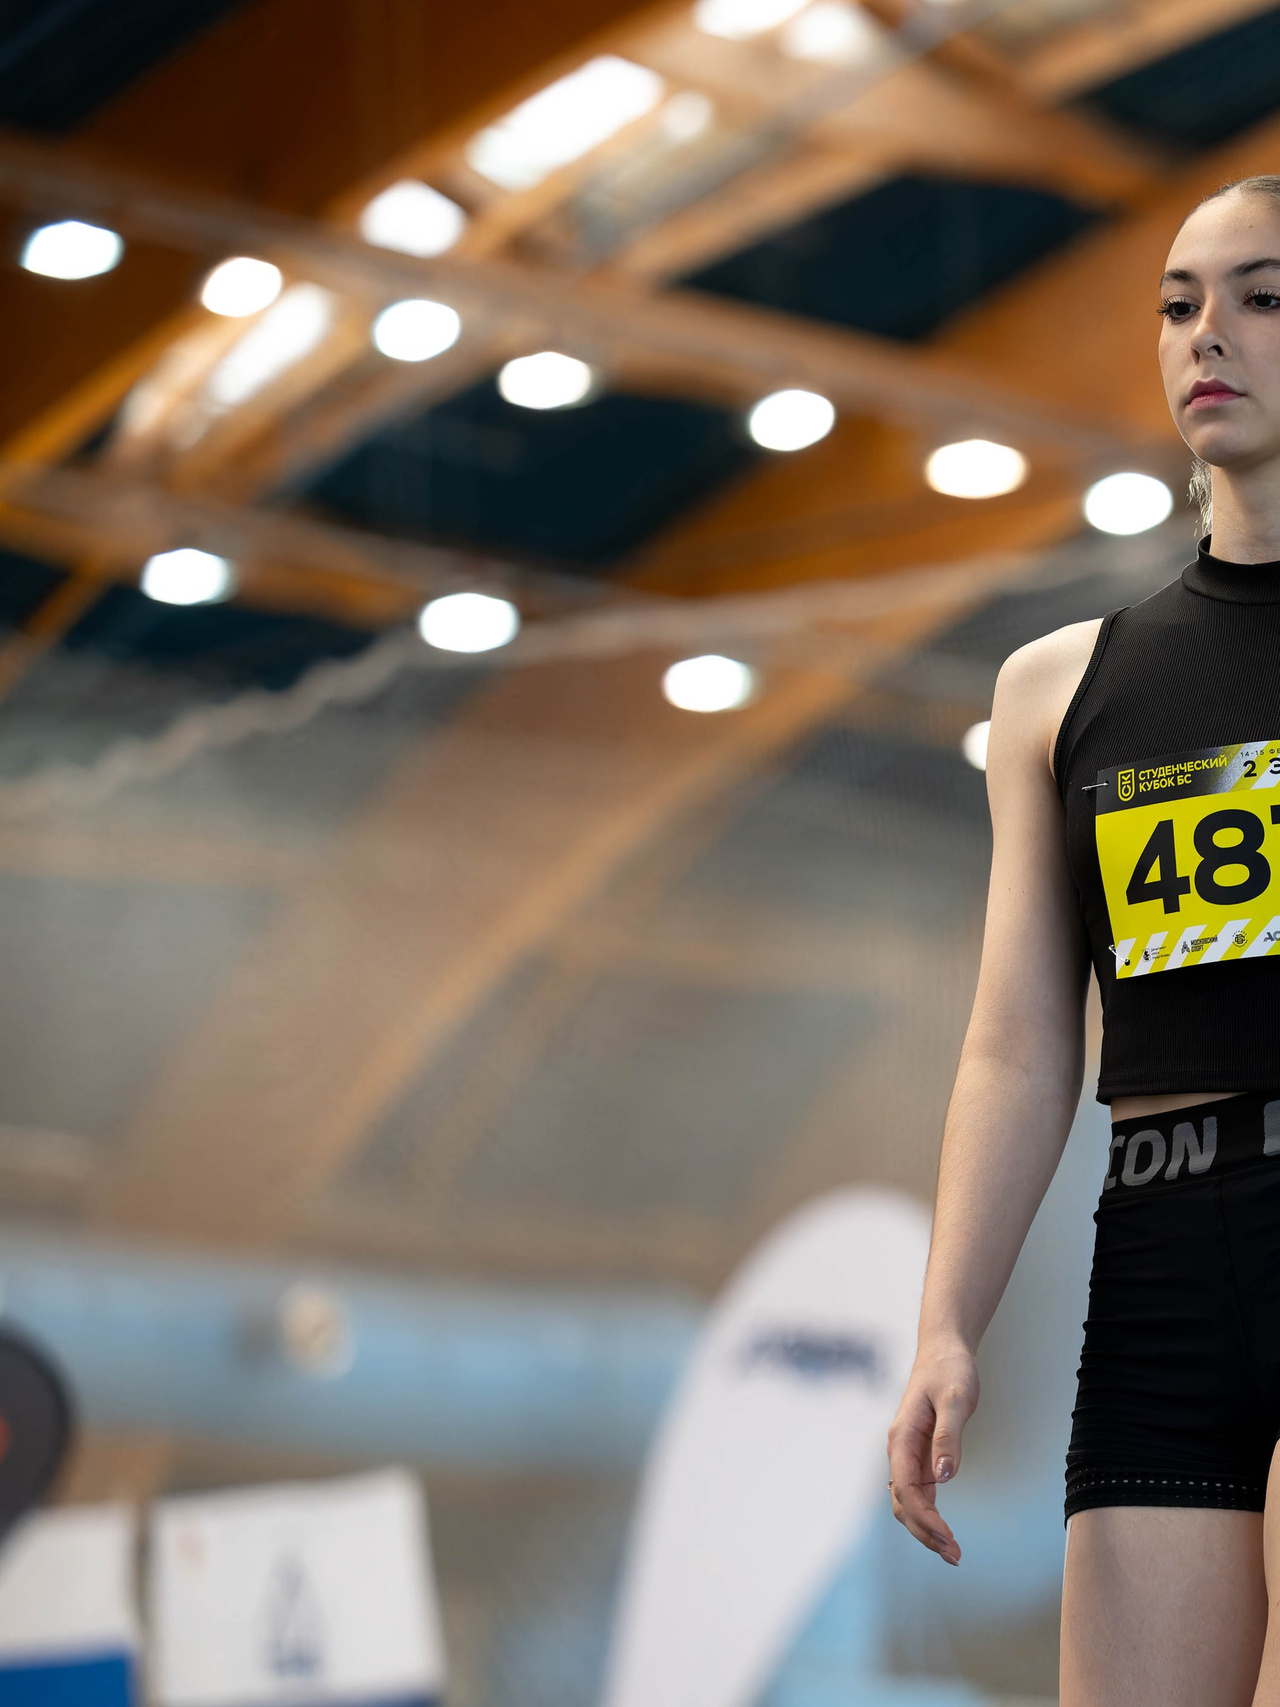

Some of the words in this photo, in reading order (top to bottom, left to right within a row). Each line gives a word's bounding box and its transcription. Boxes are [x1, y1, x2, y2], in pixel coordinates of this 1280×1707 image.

[1240, 749, 1265, 758] 14-15
[1138, 754, 1228, 781] СТУДЕНЧЕСКИЙ
[1243, 760, 1257, 778] 2
[1139, 776, 1175, 793] КУБОК
[1177, 773, 1192, 786] БС
